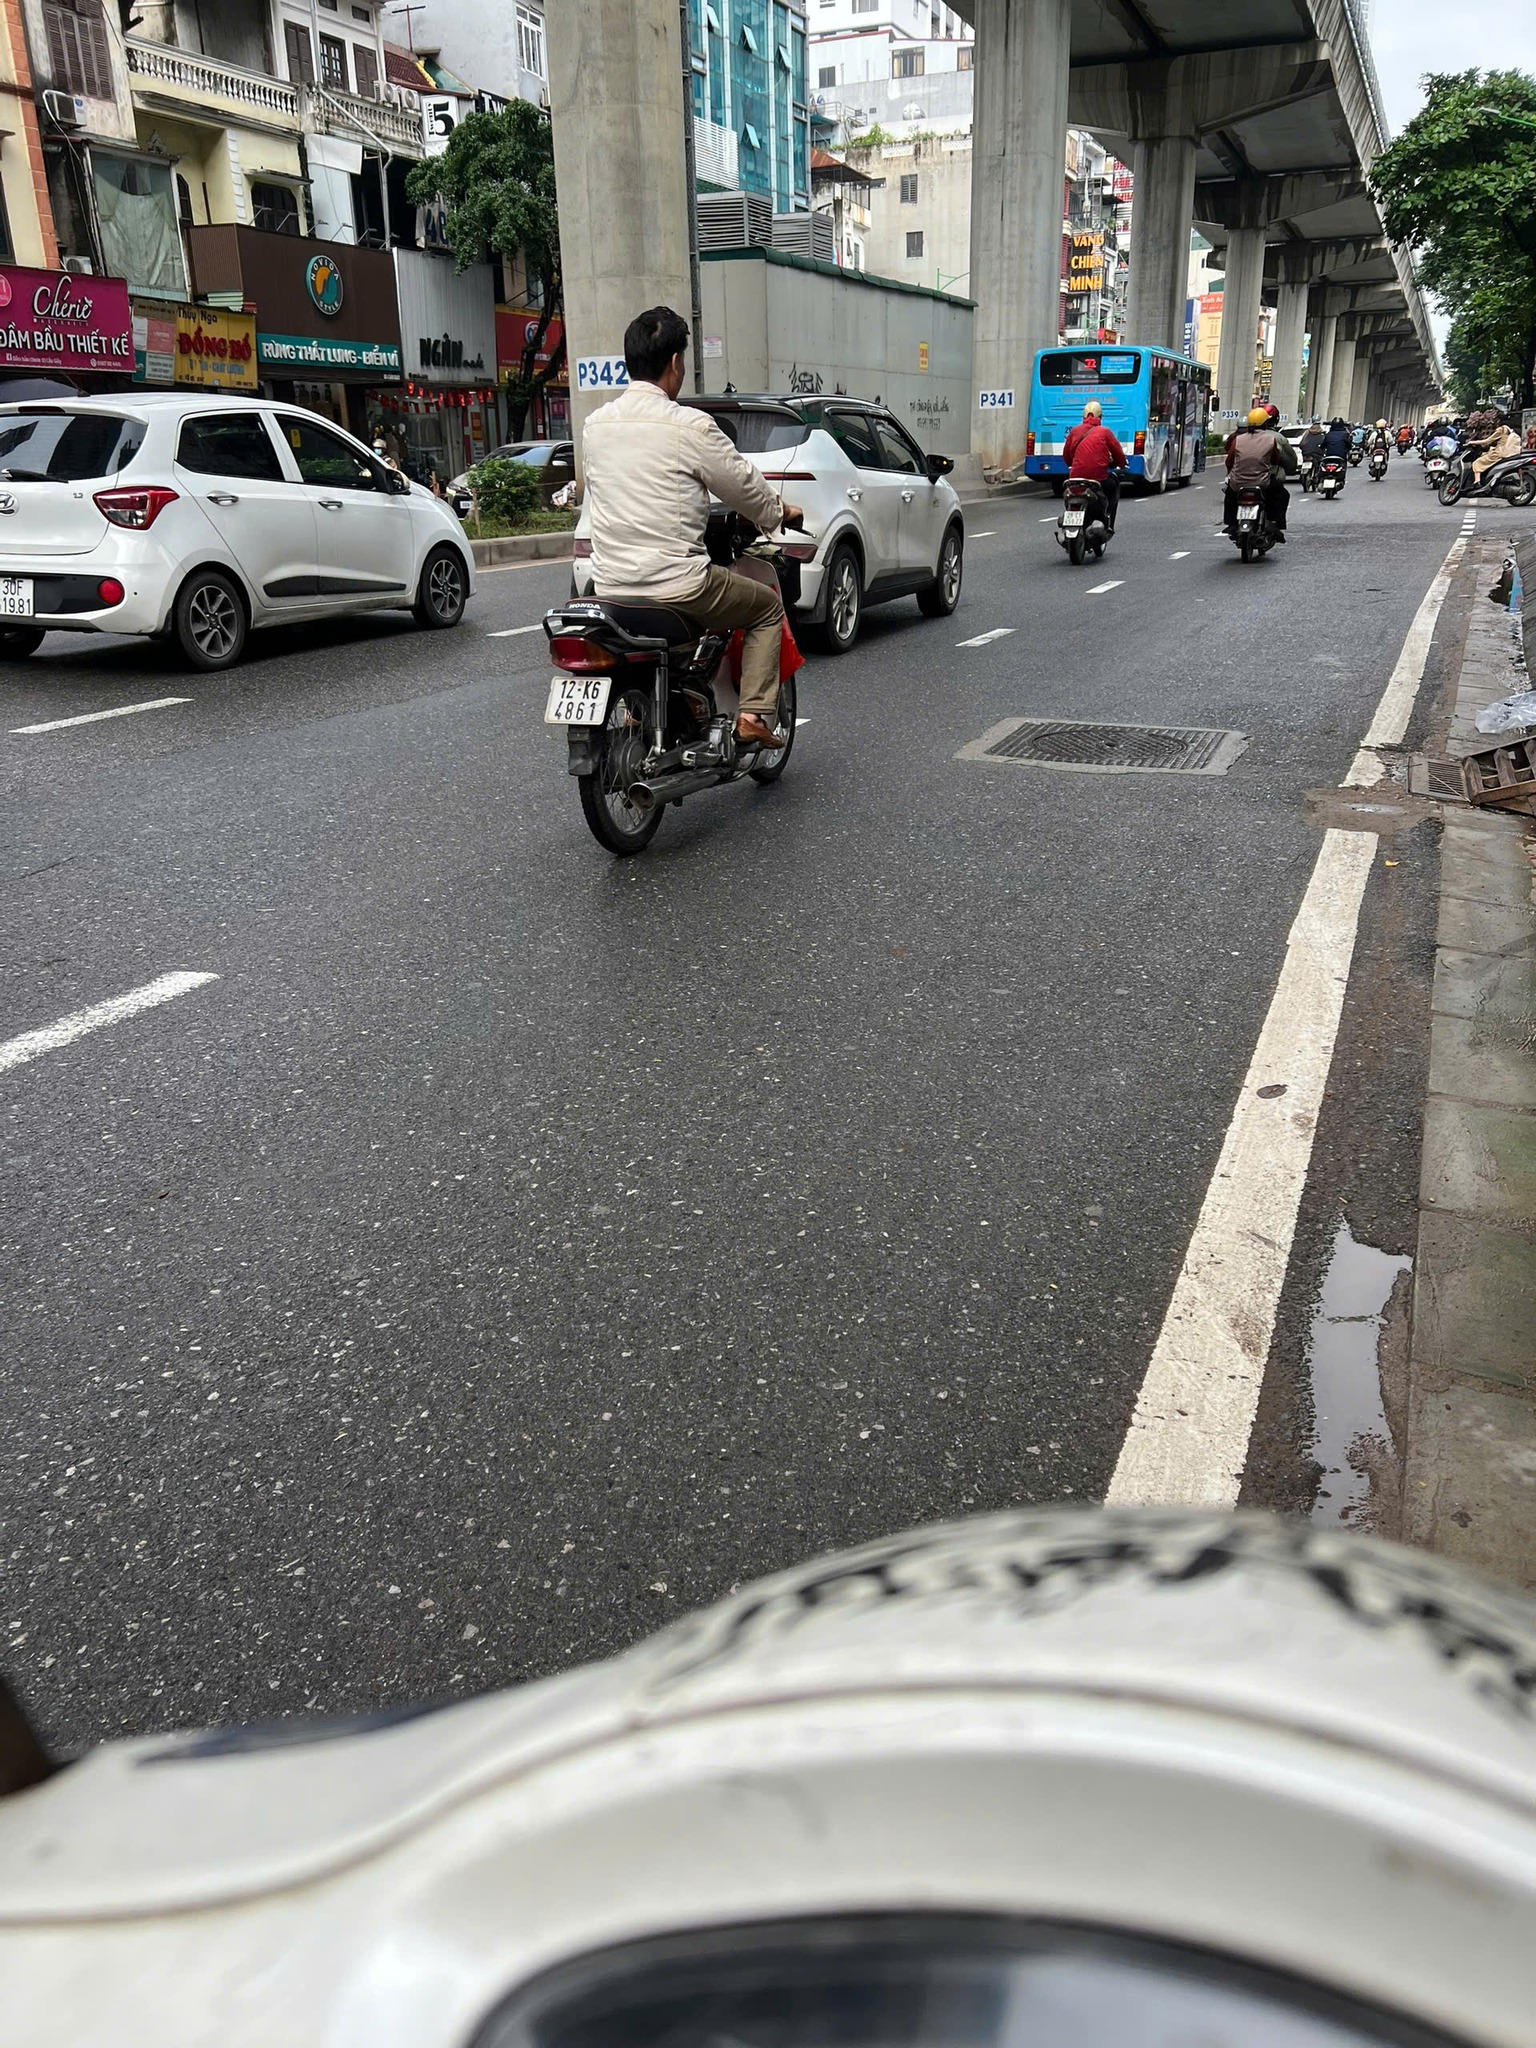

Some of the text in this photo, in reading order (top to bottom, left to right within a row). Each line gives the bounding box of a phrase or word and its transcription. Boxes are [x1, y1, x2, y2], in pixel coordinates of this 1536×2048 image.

[1069, 274, 1103, 291] MINH
[200, 309, 218, 325] Nga
[33, 324, 64, 351] BẦU
[66, 328, 107, 354] THIẾT
[111, 331, 130, 356] KẾ
[578, 360, 629, 387] P342
[980, 392, 1013, 407] P341
[2, 579, 24, 596] 30F
[0, 598, 31, 615] 19.81
[554, 701, 597, 721] 4861
